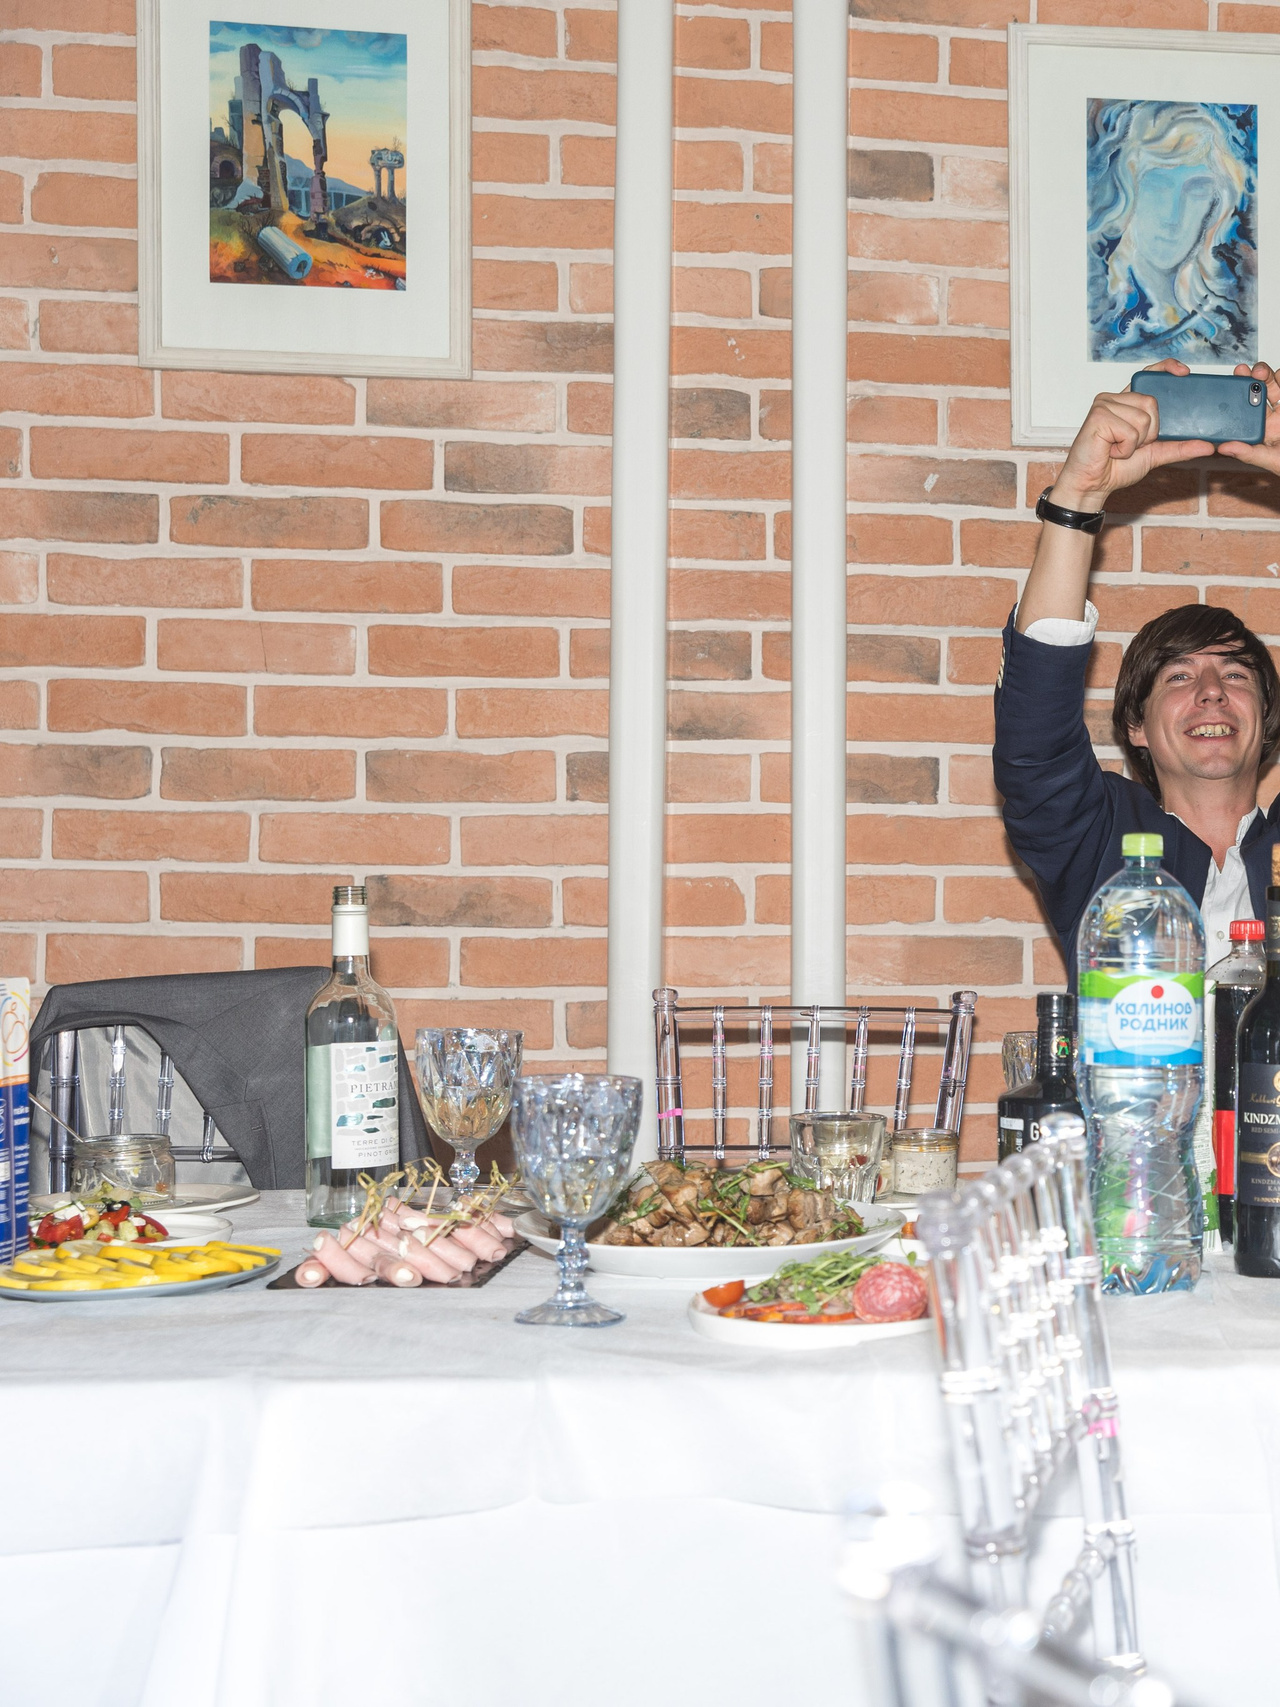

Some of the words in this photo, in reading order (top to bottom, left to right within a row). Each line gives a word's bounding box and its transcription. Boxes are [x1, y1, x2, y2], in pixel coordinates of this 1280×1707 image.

[1120, 1018, 1188, 1032] РОДНИК
[352, 1138, 379, 1146] TERRE
[358, 1150, 382, 1158] PINOT
